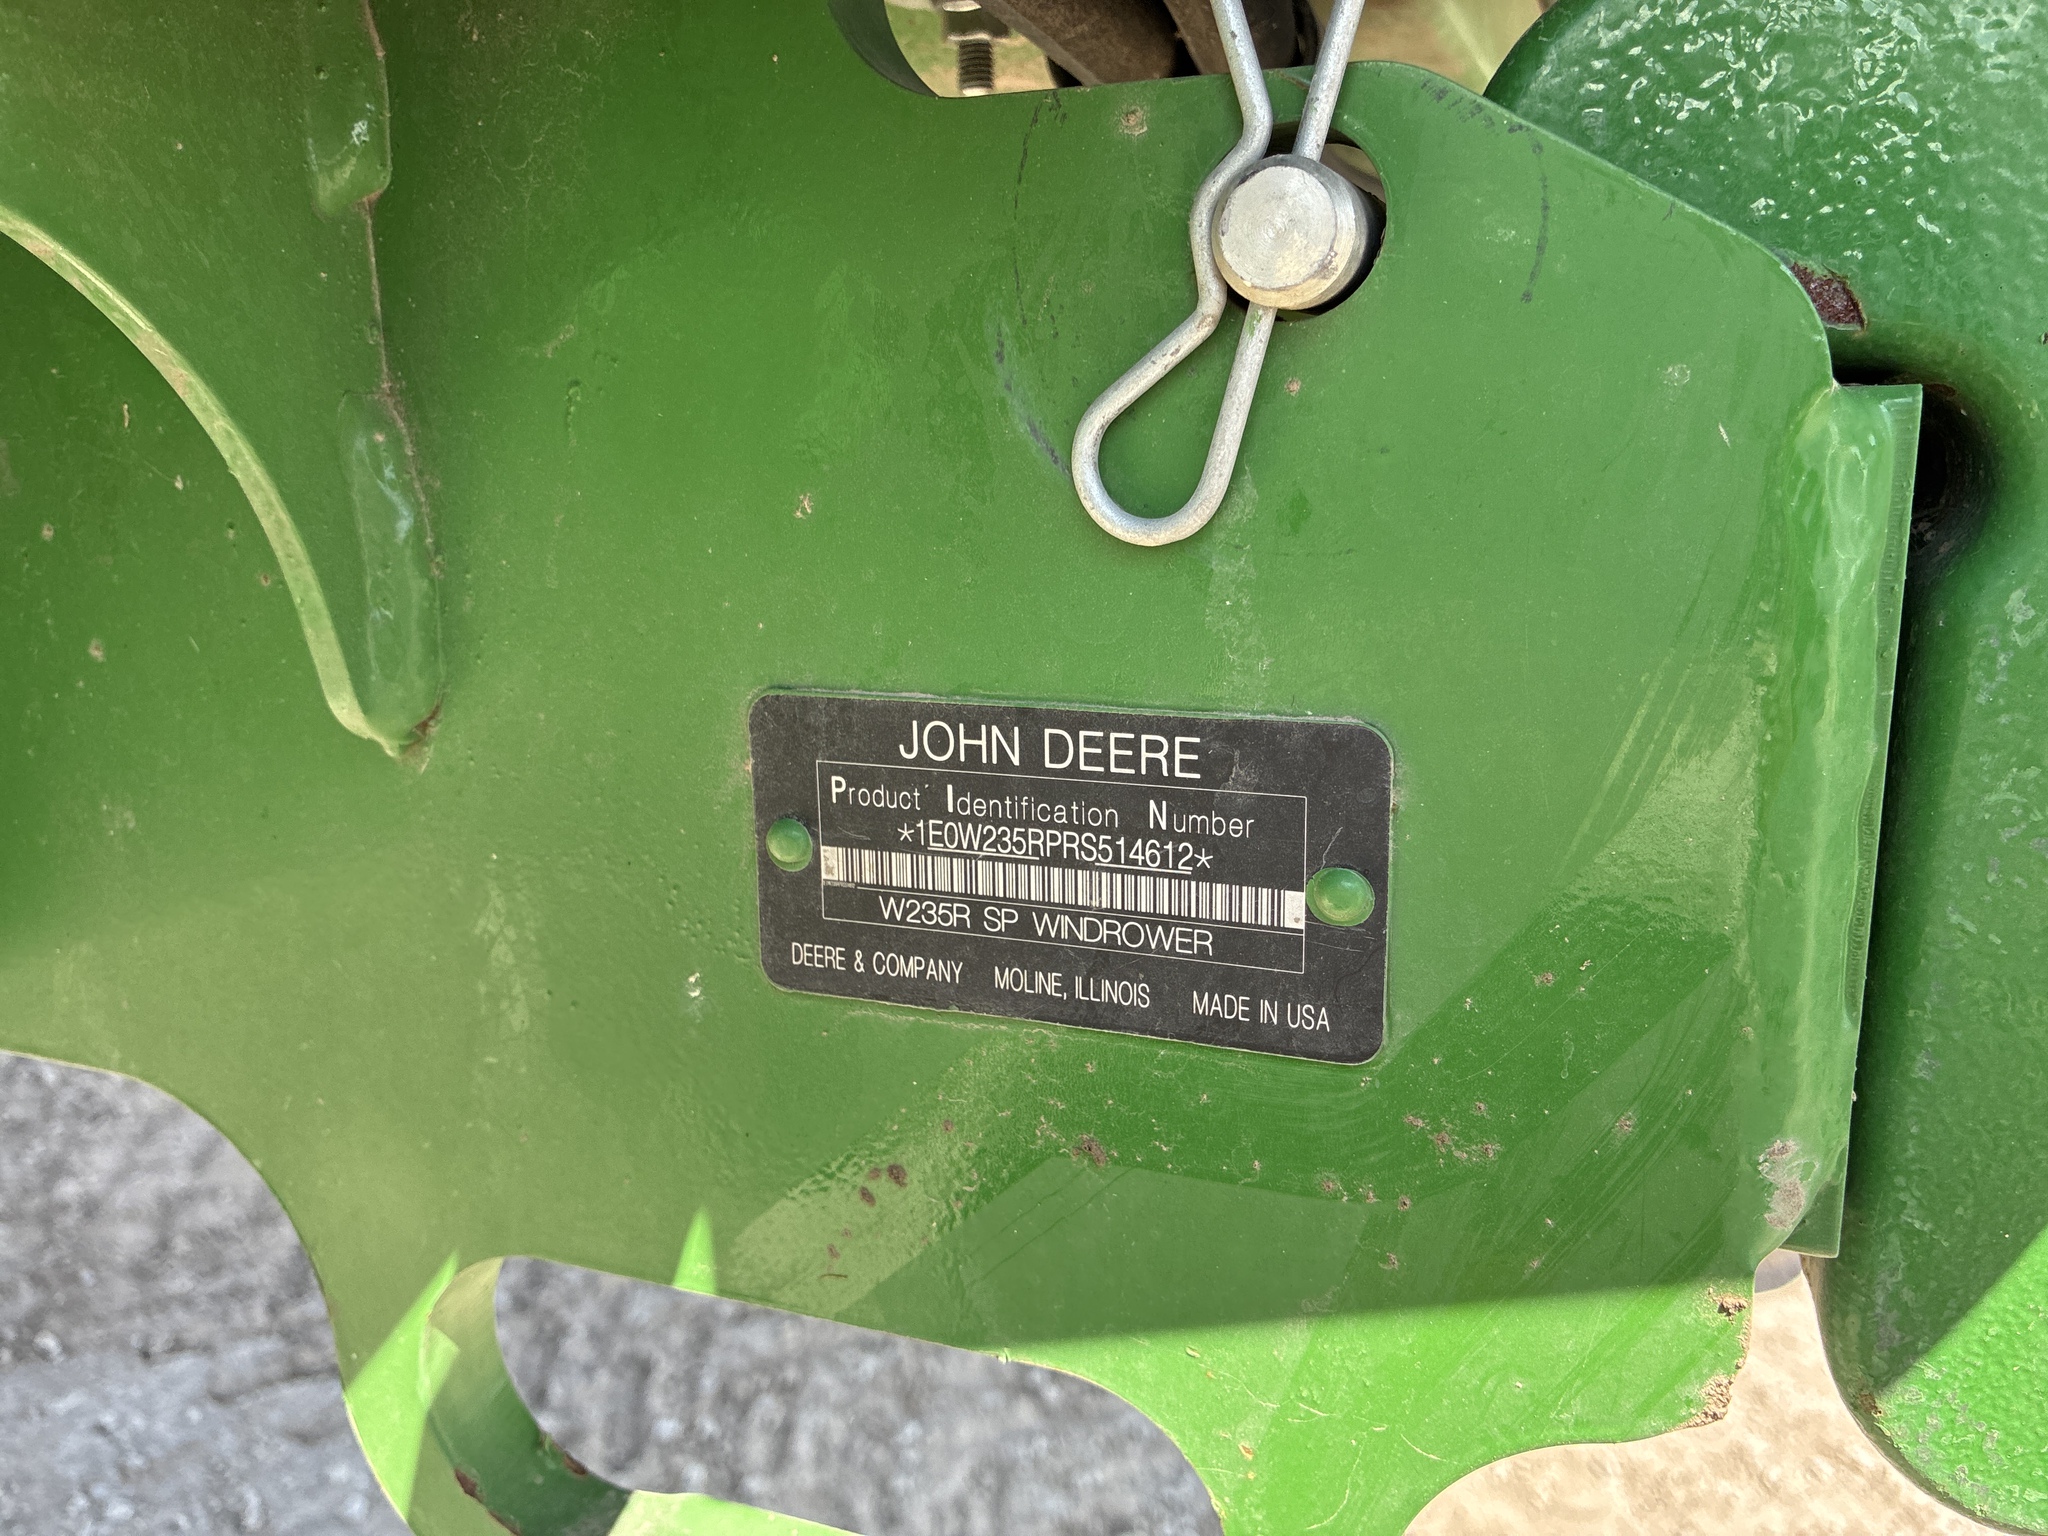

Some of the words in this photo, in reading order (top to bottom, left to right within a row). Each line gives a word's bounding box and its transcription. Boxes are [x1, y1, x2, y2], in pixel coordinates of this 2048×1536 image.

[899, 719, 1020, 766] JOHN
[1043, 727, 1201, 779] DEERE
[830, 775, 921, 811] Product
[946, 783, 1119, 829] Identification
[1149, 799, 1255, 838] Number
[879, 894, 971, 929] W235R
[983, 905, 1019, 933] SP
[1032, 910, 1214, 957] WINDROWER
[791, 941, 846, 971] DEERE
[853, 949, 865, 973] &
[872, 951, 963, 984] COMPANY
[994, 965, 1068, 1001] MOLINE,
[1074, 975, 1150, 1009] ILLINOIS
[1192, 990, 1250, 1022] MADE
[1260, 998, 1278, 1026] IN
[1287, 1003, 1330, 1032] USA
